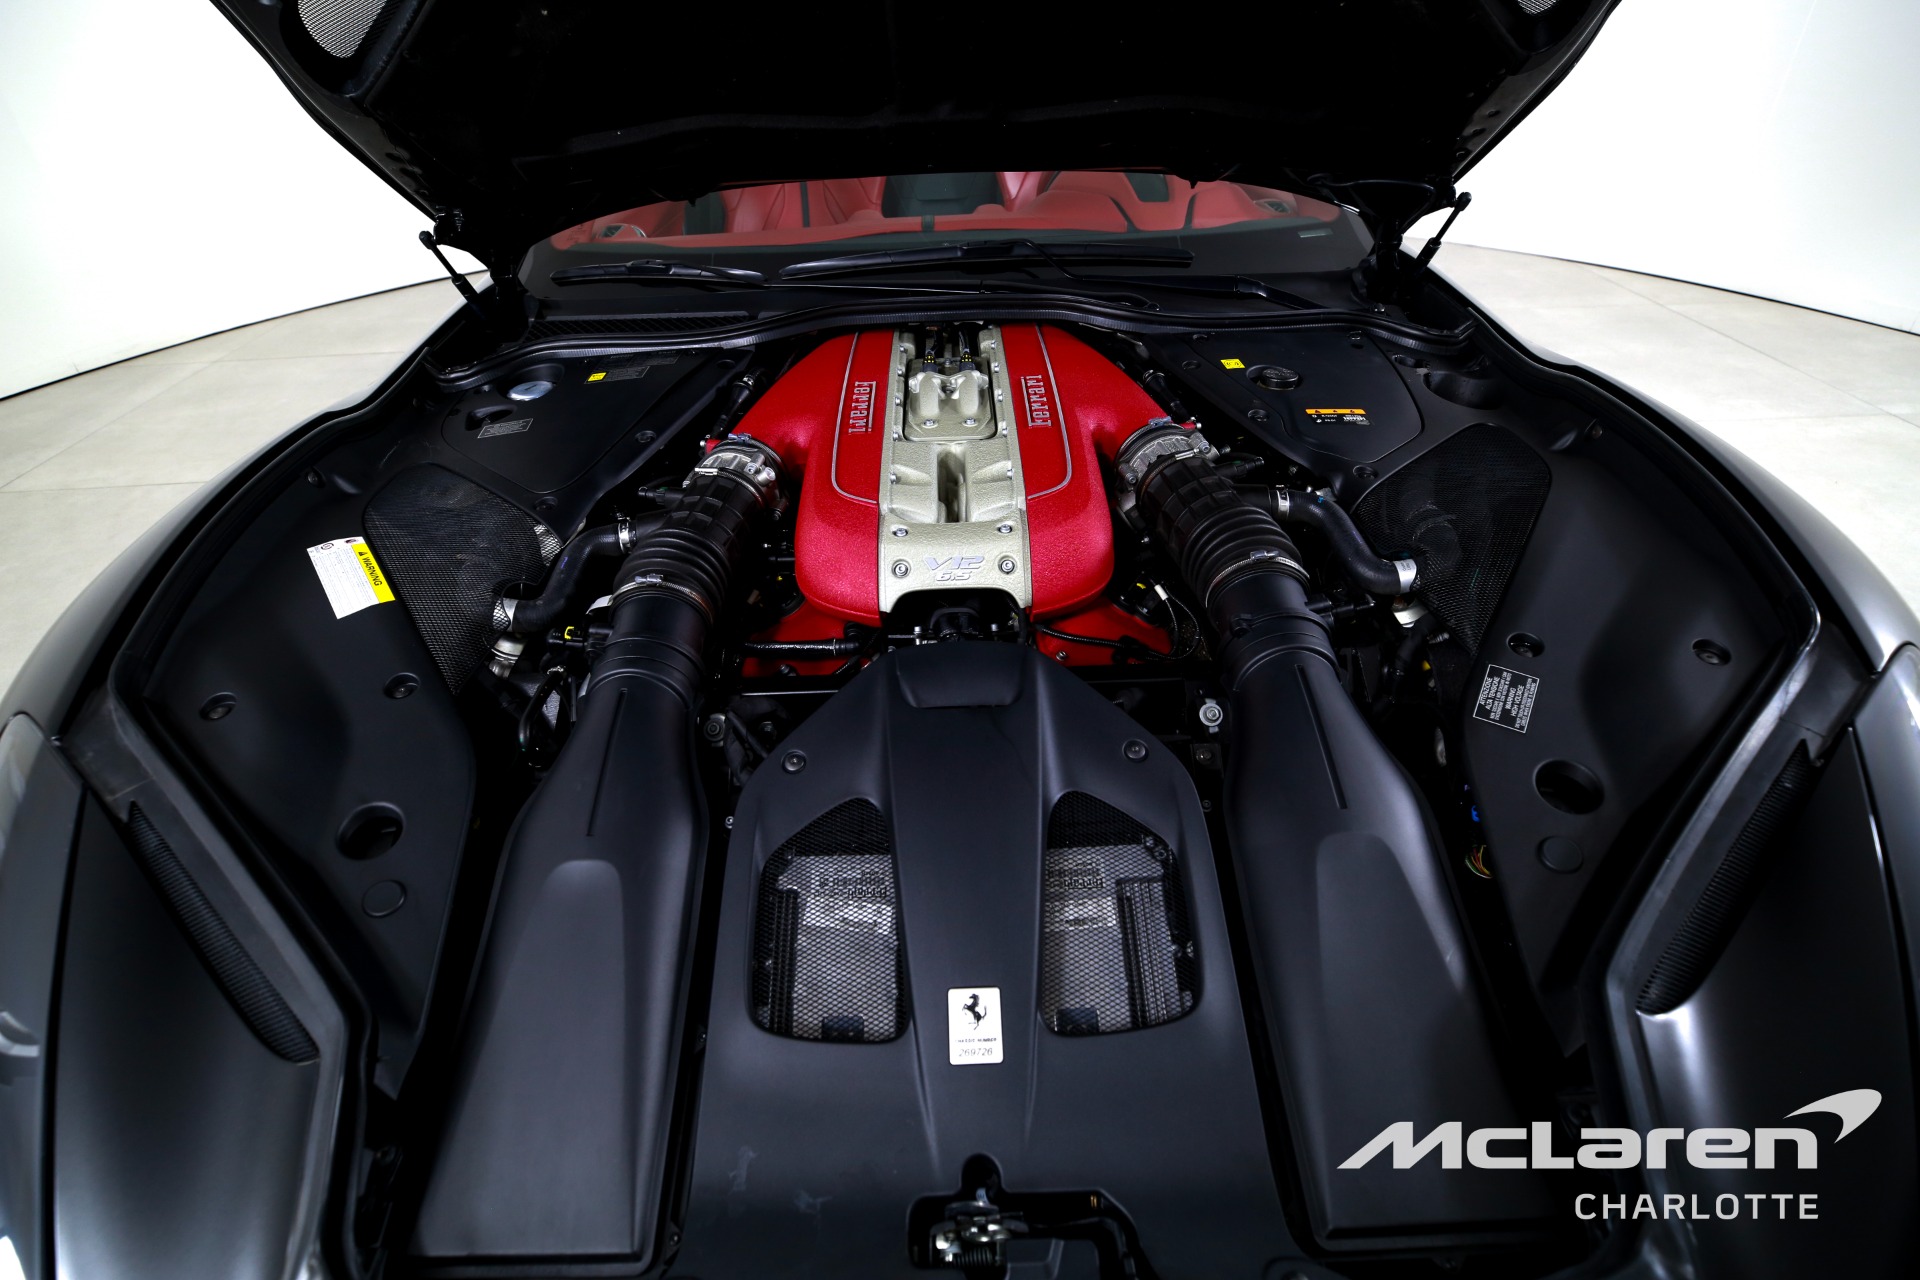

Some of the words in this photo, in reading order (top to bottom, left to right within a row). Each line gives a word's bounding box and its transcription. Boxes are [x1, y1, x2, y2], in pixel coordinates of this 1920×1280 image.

[848, 380, 876, 434] Ferrari
[1021, 374, 1051, 429] Ferrari
[362, 556, 383, 586] WARNING
[924, 556, 985, 571] V12
[1505, 687, 1517, 710] WARNING
